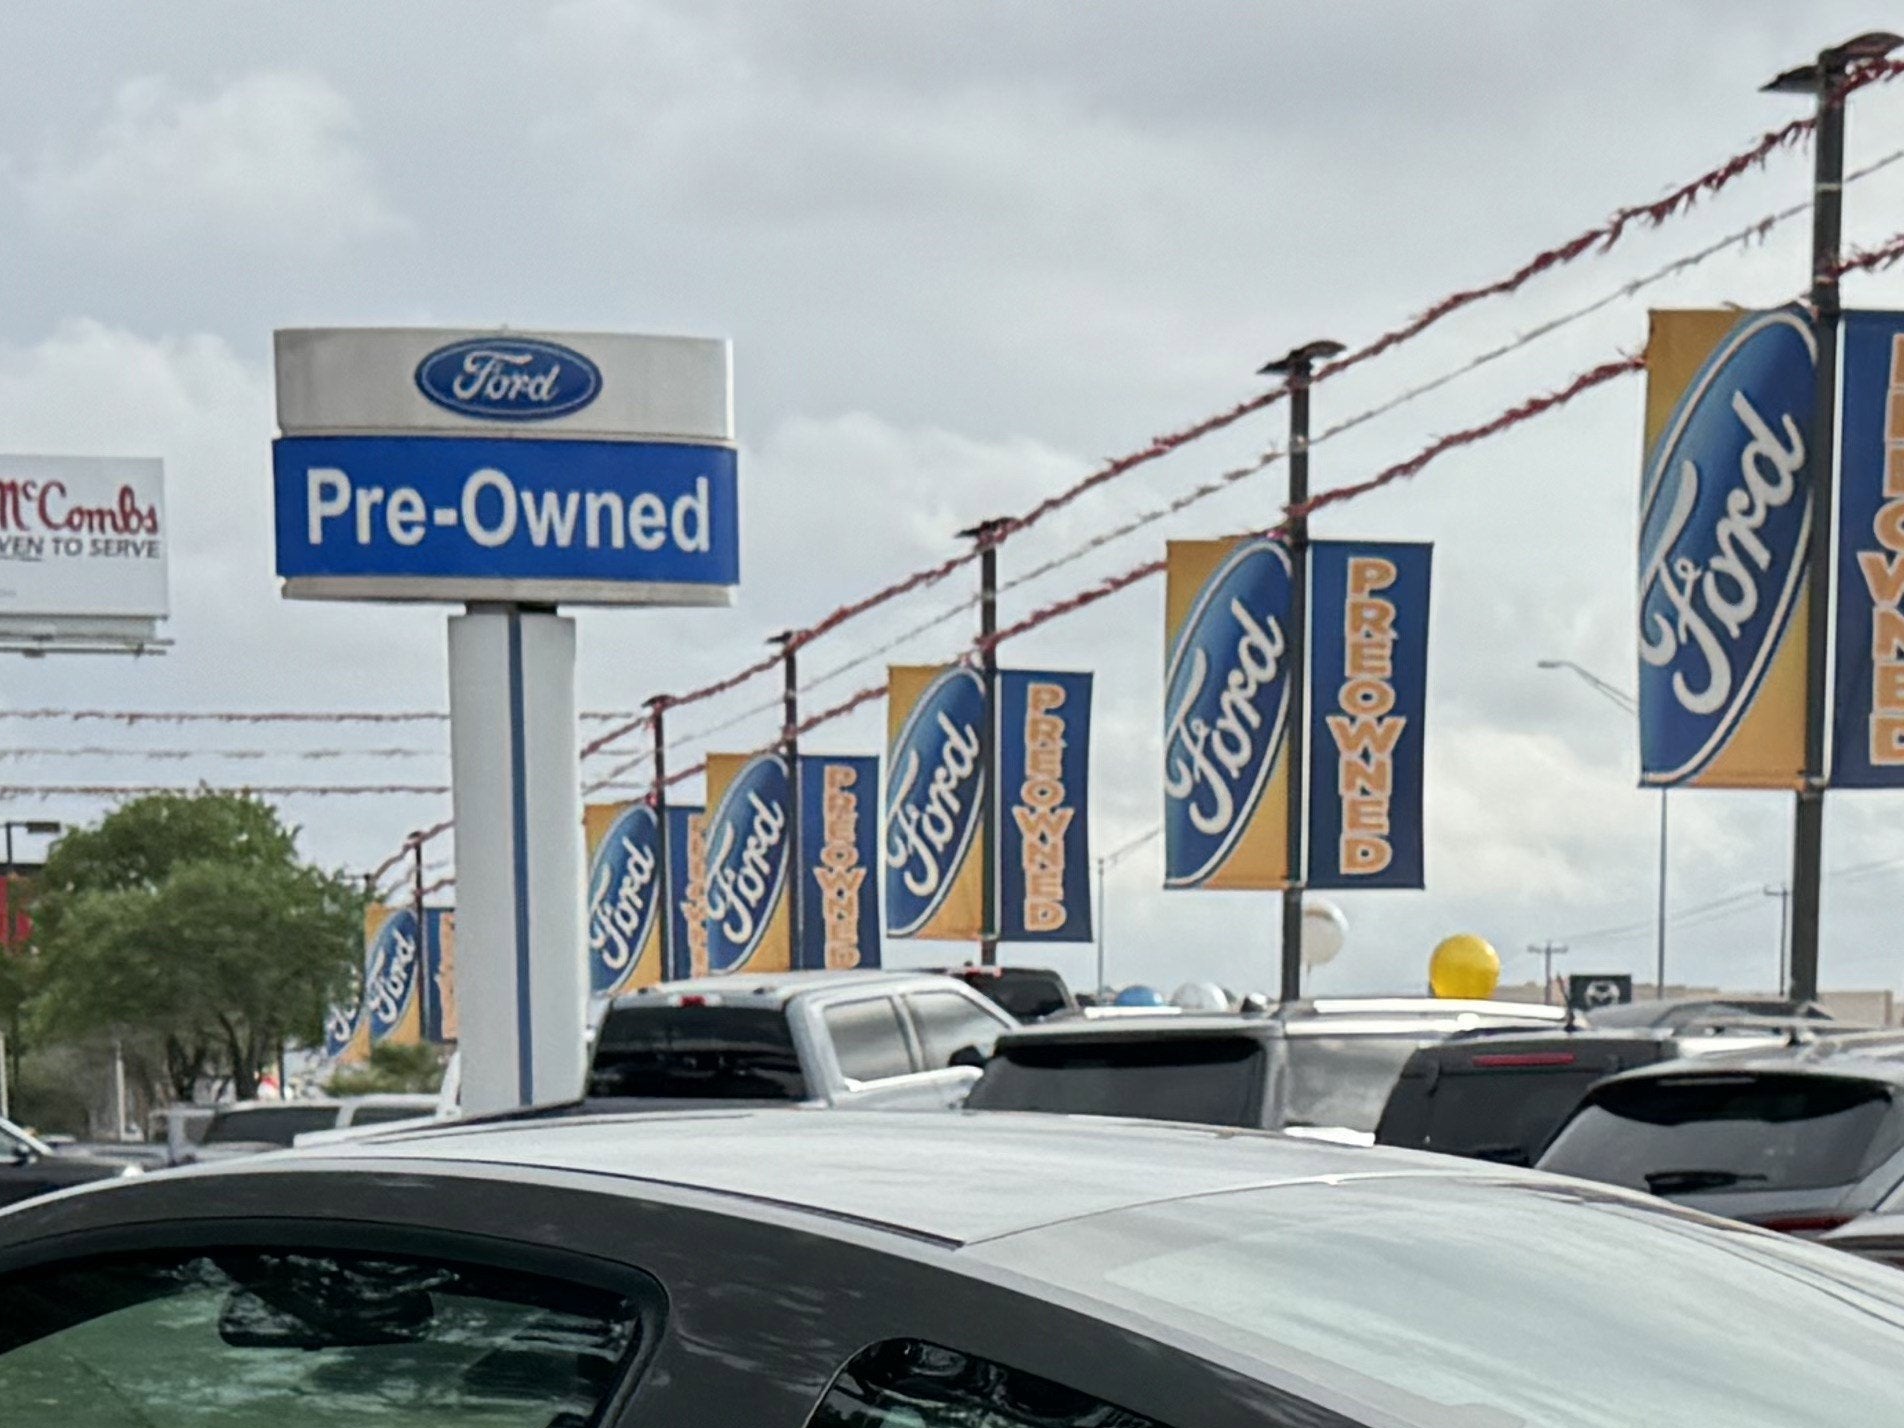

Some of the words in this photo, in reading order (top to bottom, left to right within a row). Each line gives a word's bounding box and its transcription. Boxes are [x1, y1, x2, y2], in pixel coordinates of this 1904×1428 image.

[452, 351, 560, 401] Ford
[51, 537, 84, 557] TO
[89, 538, 161, 559] SERVE
[307, 467, 710, 552] Pre-Owned
[1640, 390, 1805, 714] Ford
[1165, 598, 1284, 834] Ford
[1325, 556, 1407, 874] PREOWNED
[707, 789, 784, 944] Ford
[887, 711, 979, 896] Ford
[590, 836, 654, 969] Ford
